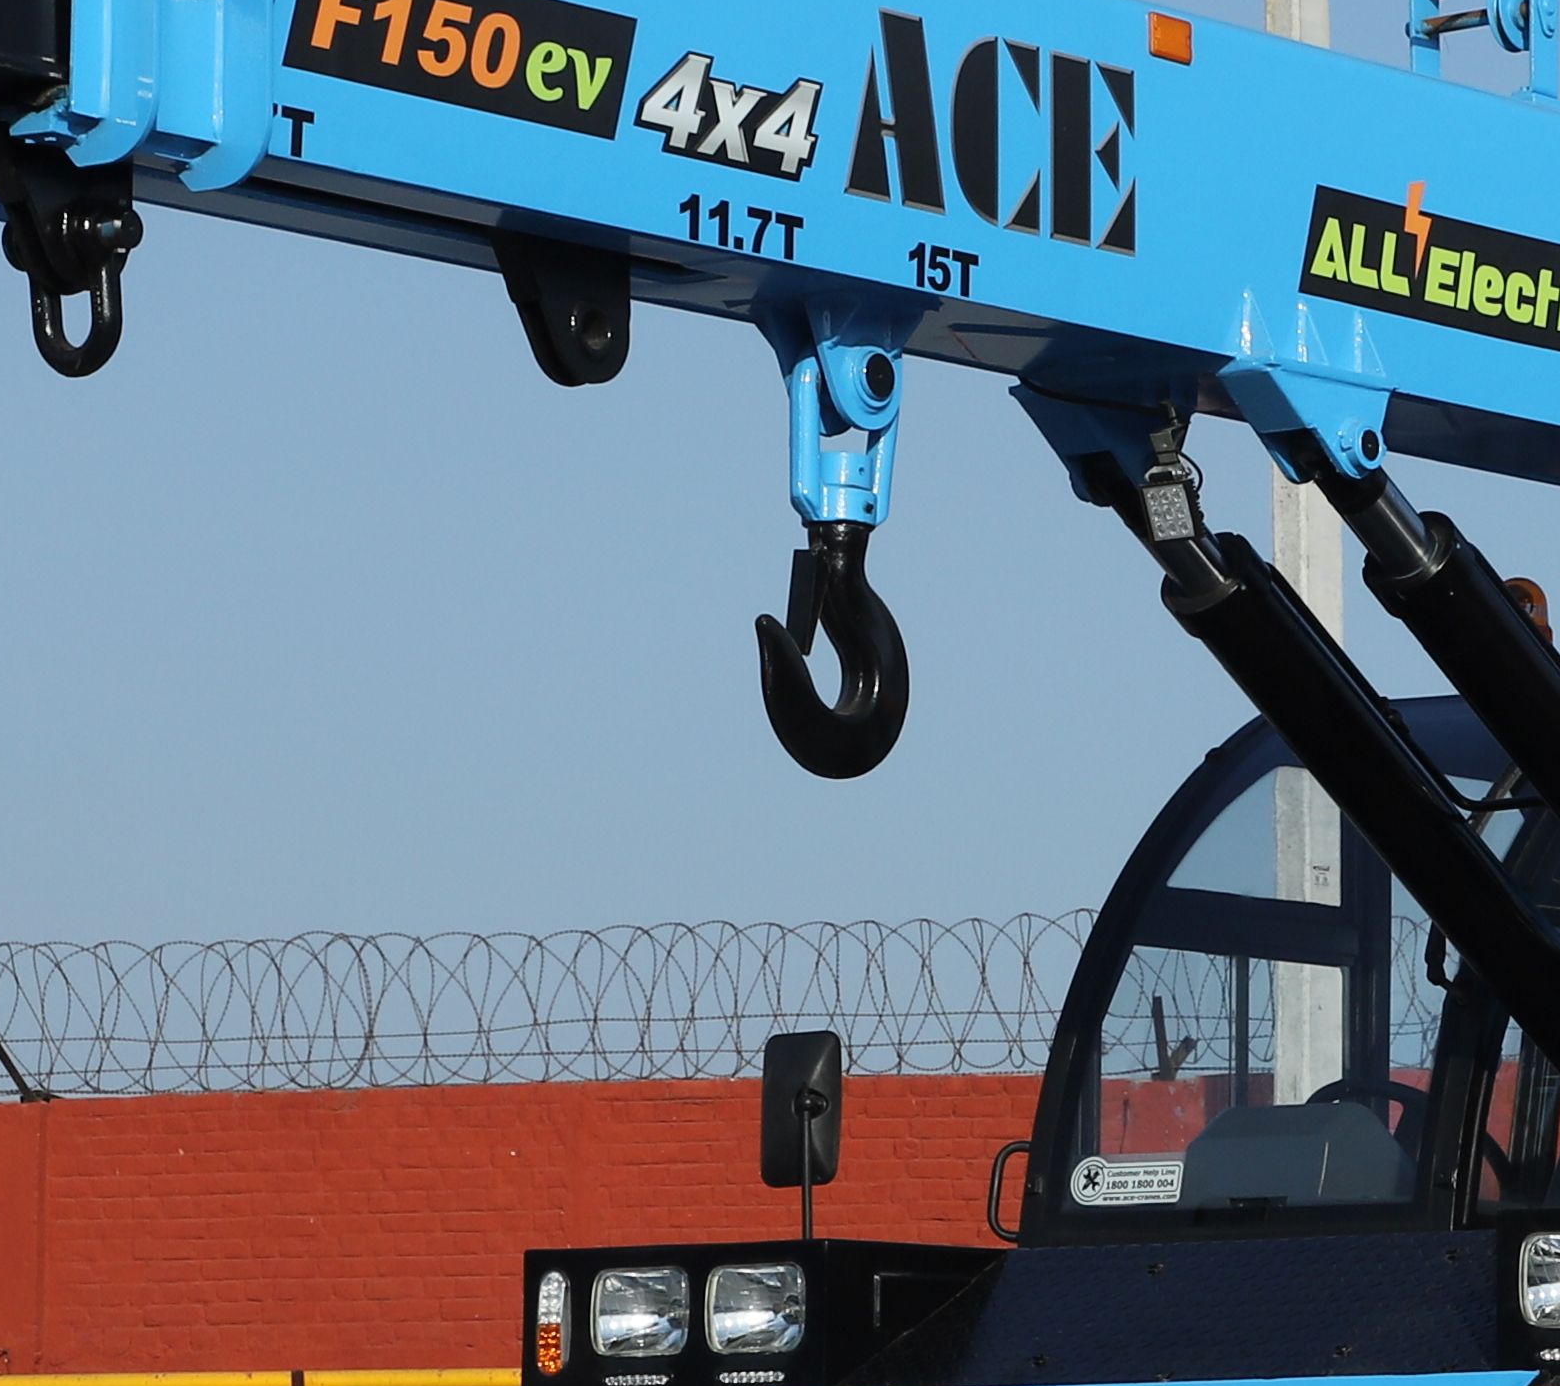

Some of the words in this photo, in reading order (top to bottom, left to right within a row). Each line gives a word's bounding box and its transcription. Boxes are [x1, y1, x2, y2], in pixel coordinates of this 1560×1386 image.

[636, 52, 822, 180] 4x4
[843, 7, 1136, 256] ACE
[678, 193, 804, 261] 11.7T
[1309, 216, 1411, 297] ALL
[908, 242, 979, 297] 15T
[1102, 1193, 1178, 1202] www.ace-cranes.com
[1105, 1180, 1129, 1190] 1800
[1131, 1179, 1154, 1189] 1800
[1156, 1179, 1174, 1188] 004
[1107, 1169, 1141, 1178] Customer
[1142, 1169, 1159, 1177] Help
[1161, 1168, 1176, 1176] Line
